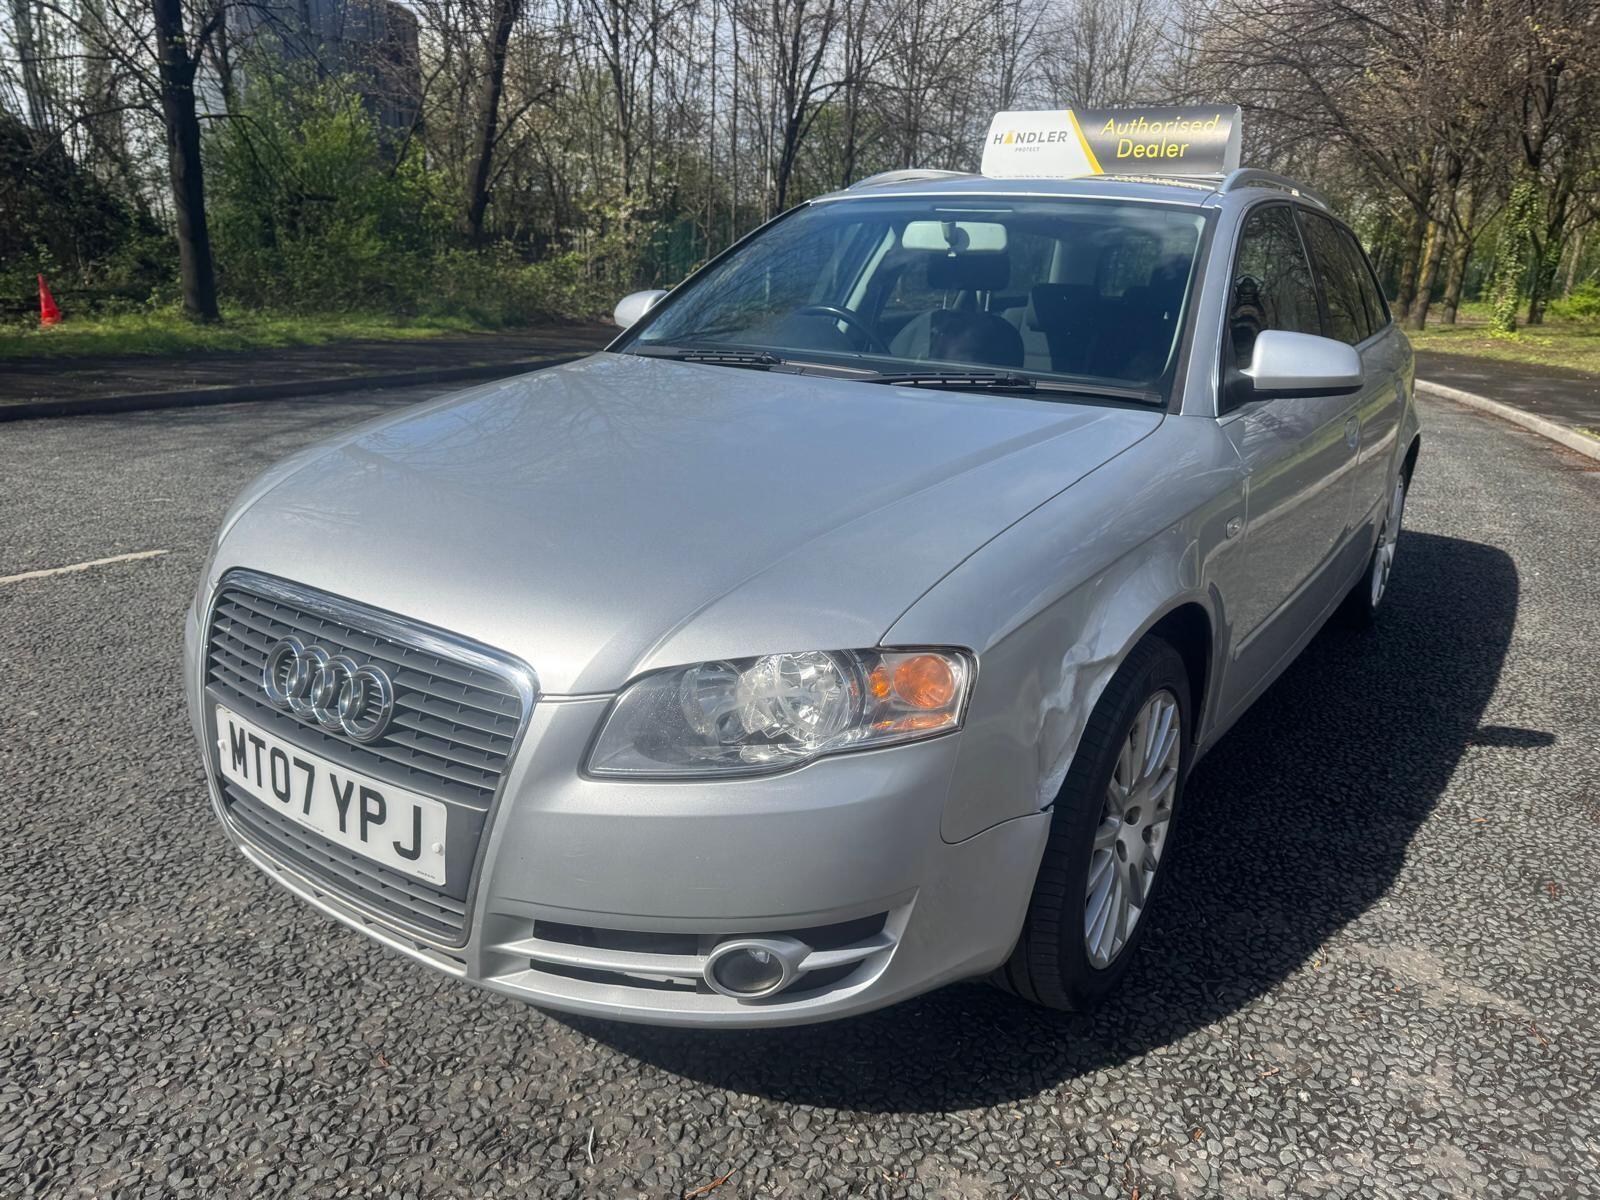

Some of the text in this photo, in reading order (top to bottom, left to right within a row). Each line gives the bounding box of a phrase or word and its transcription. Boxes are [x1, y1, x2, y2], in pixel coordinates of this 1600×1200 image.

[1100, 114, 1220, 135] Authorised
[993, 131, 1068, 144] HANDLER
[1117, 137, 1190, 158] Dealer
[229, 720, 422, 861] MT07 YPJ
